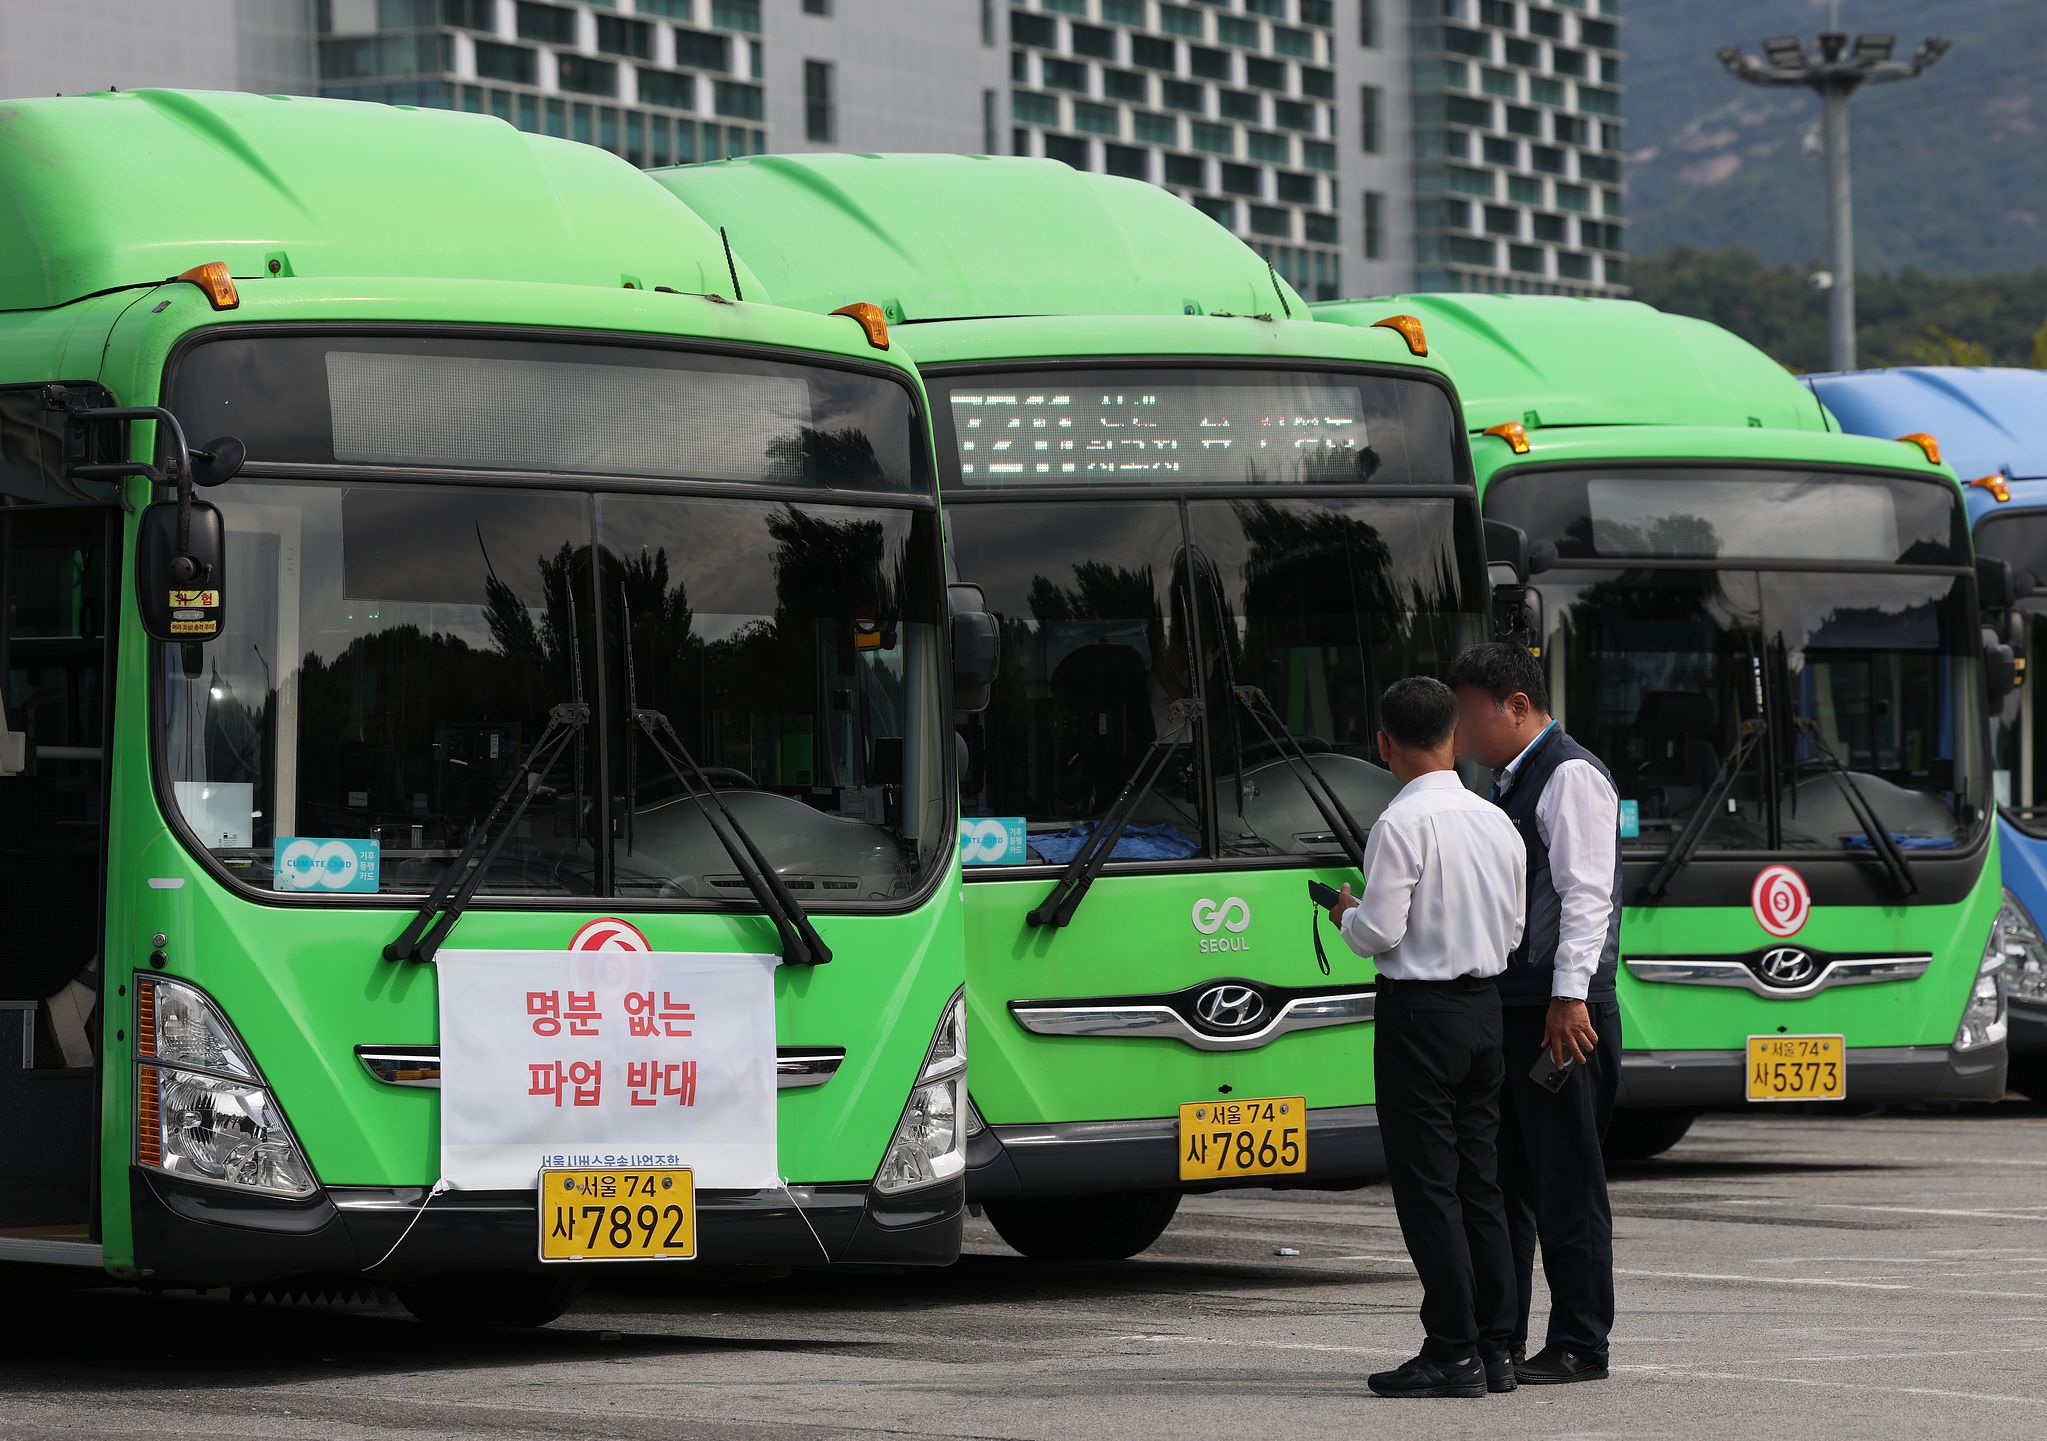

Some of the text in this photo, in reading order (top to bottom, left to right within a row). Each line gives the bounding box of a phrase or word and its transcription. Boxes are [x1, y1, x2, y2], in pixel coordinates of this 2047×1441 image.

[286, 859, 352, 869] CLIMATE CARD
[359, 861, 375, 871] 동행
[360, 851, 375, 861] 기후
[359, 872, 375, 881] 카드
[1191, 896, 1251, 935] GO
[1199, 937, 1249, 953] SEOUL
[526, 990, 696, 1037] 명분 없는
[1772, 1042, 1819, 1057] 서울 74
[528, 1060, 697, 1107] 파업 반대
[1754, 1062, 1837, 1092] 사5373
[1211, 1103, 1275, 1125] 서울 74
[1187, 1127, 1299, 1171] 사7865
[581, 1175, 656, 1198] 서울 74
[552, 1204, 684, 1249] 사7892
